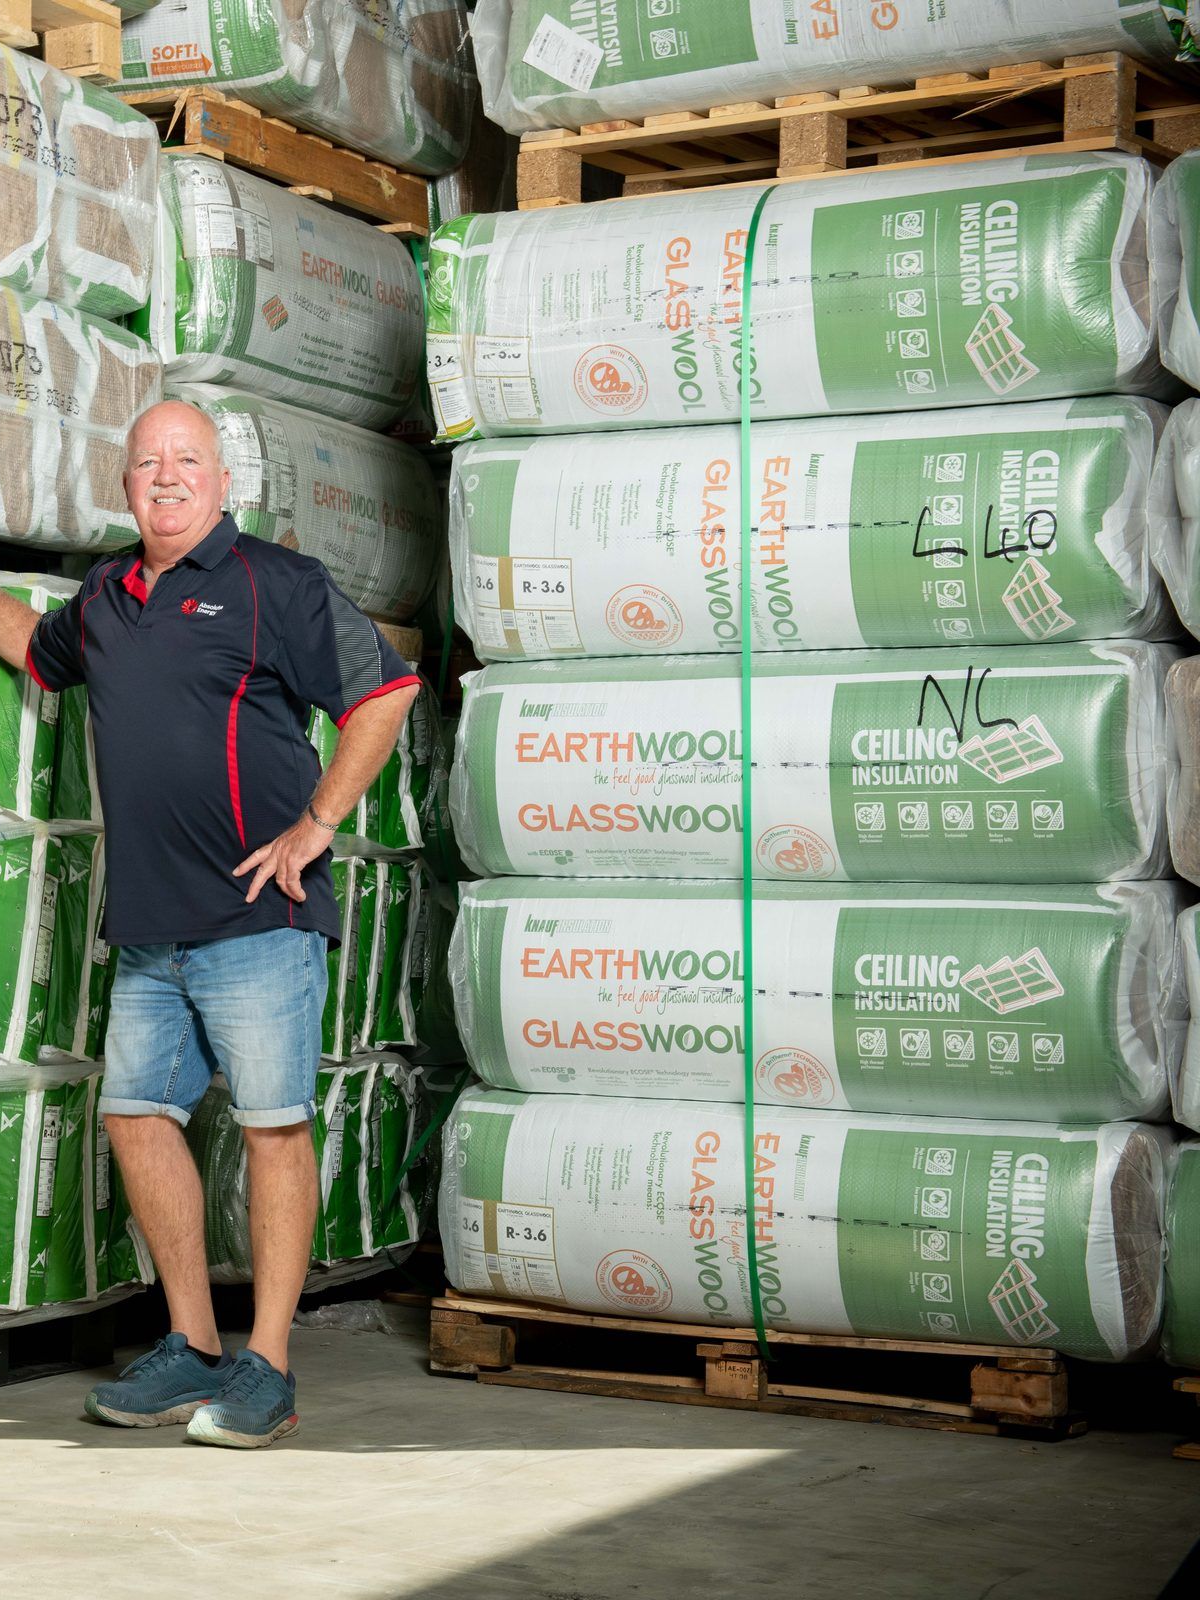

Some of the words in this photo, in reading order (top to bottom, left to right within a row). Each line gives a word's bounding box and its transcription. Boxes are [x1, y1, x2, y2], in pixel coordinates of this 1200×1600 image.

[152, 43, 198, 61] SOFT!
[765, 223, 783, 247] KNAUF
[984, 200, 1020, 304] CEILING
[623, 246, 635, 291] Technology
[960, 202, 982, 306] INSULATION
[302, 251, 373, 299] EARTHWOOL
[632, 243, 645, 302] Revolutionary
[664, 236, 707, 413] GLASSWOOL
[804, 453, 824, 481] KNAUF
[313, 481, 378, 522] EARTHWOOL
[655, 463, 671, 509] Technology
[665, 461, 682, 521] Revolutionary
[999, 450, 1024, 560] INSULATION
[1024, 449, 1060, 558] CEILING
[699, 458, 743, 649] GLASSWOOL
[759, 455, 804, 648] EARTHWOOL
[541, 580, 565, 593] 3.6
[196, 607, 218, 616] Energy
[199, 602, 224, 611] Absolute
[519, 699, 553, 721] KNAUF
[552, 702, 608, 718] INSULATION
[515, 729, 744, 763] EARTHWOOL
[850, 727, 959, 762] CEILING
[594, 769, 609, 785] the
[612, 767, 631, 785] feel
[629, 769, 656, 796] good
[653, 769, 697, 796] glasswool
[700, 768, 744, 785] insulation
[851, 764, 959, 787] INSULATION
[518, 803, 744, 833] GLASSWOOL
[539, 849, 564, 857] ECOSE
[524, 914, 560, 937] KNAUF
[558, 918, 612, 934] INSULATION
[520, 947, 745, 981] EARTHWOOL
[854, 953, 961, 988] CEILING
[598, 986, 613, 1003] the
[617, 985, 635, 1004] feel
[635, 988, 660, 1015] good
[660, 988, 700, 1015] glasswool
[703, 987, 745, 1005] insulation
[854, 990, 961, 1013] INSULATION
[522, 1018, 745, 1053] GLASSWOOL
[542, 1066, 566, 1074] ECOSE
[646, 1131, 662, 1177] Technology
[655, 1131, 672, 1188] Revolutionary
[794, 1133, 816, 1159] KNAUF
[646, 1179, 654, 1211] means:
[985, 1149, 1014, 1258] INSULATION
[1010, 1152, 1050, 1260] CEILING
[497, 1208, 524, 1216] EARTHWOOL
[525, 1210, 552, 1218] GLASSWOOL
[689, 1130, 732, 1320] GLASSWOOL
[729, 1219, 745, 1238] feel
[753, 1131, 791, 1324] EARTHWOOL
[523, 1227, 547, 1242] 3.6
